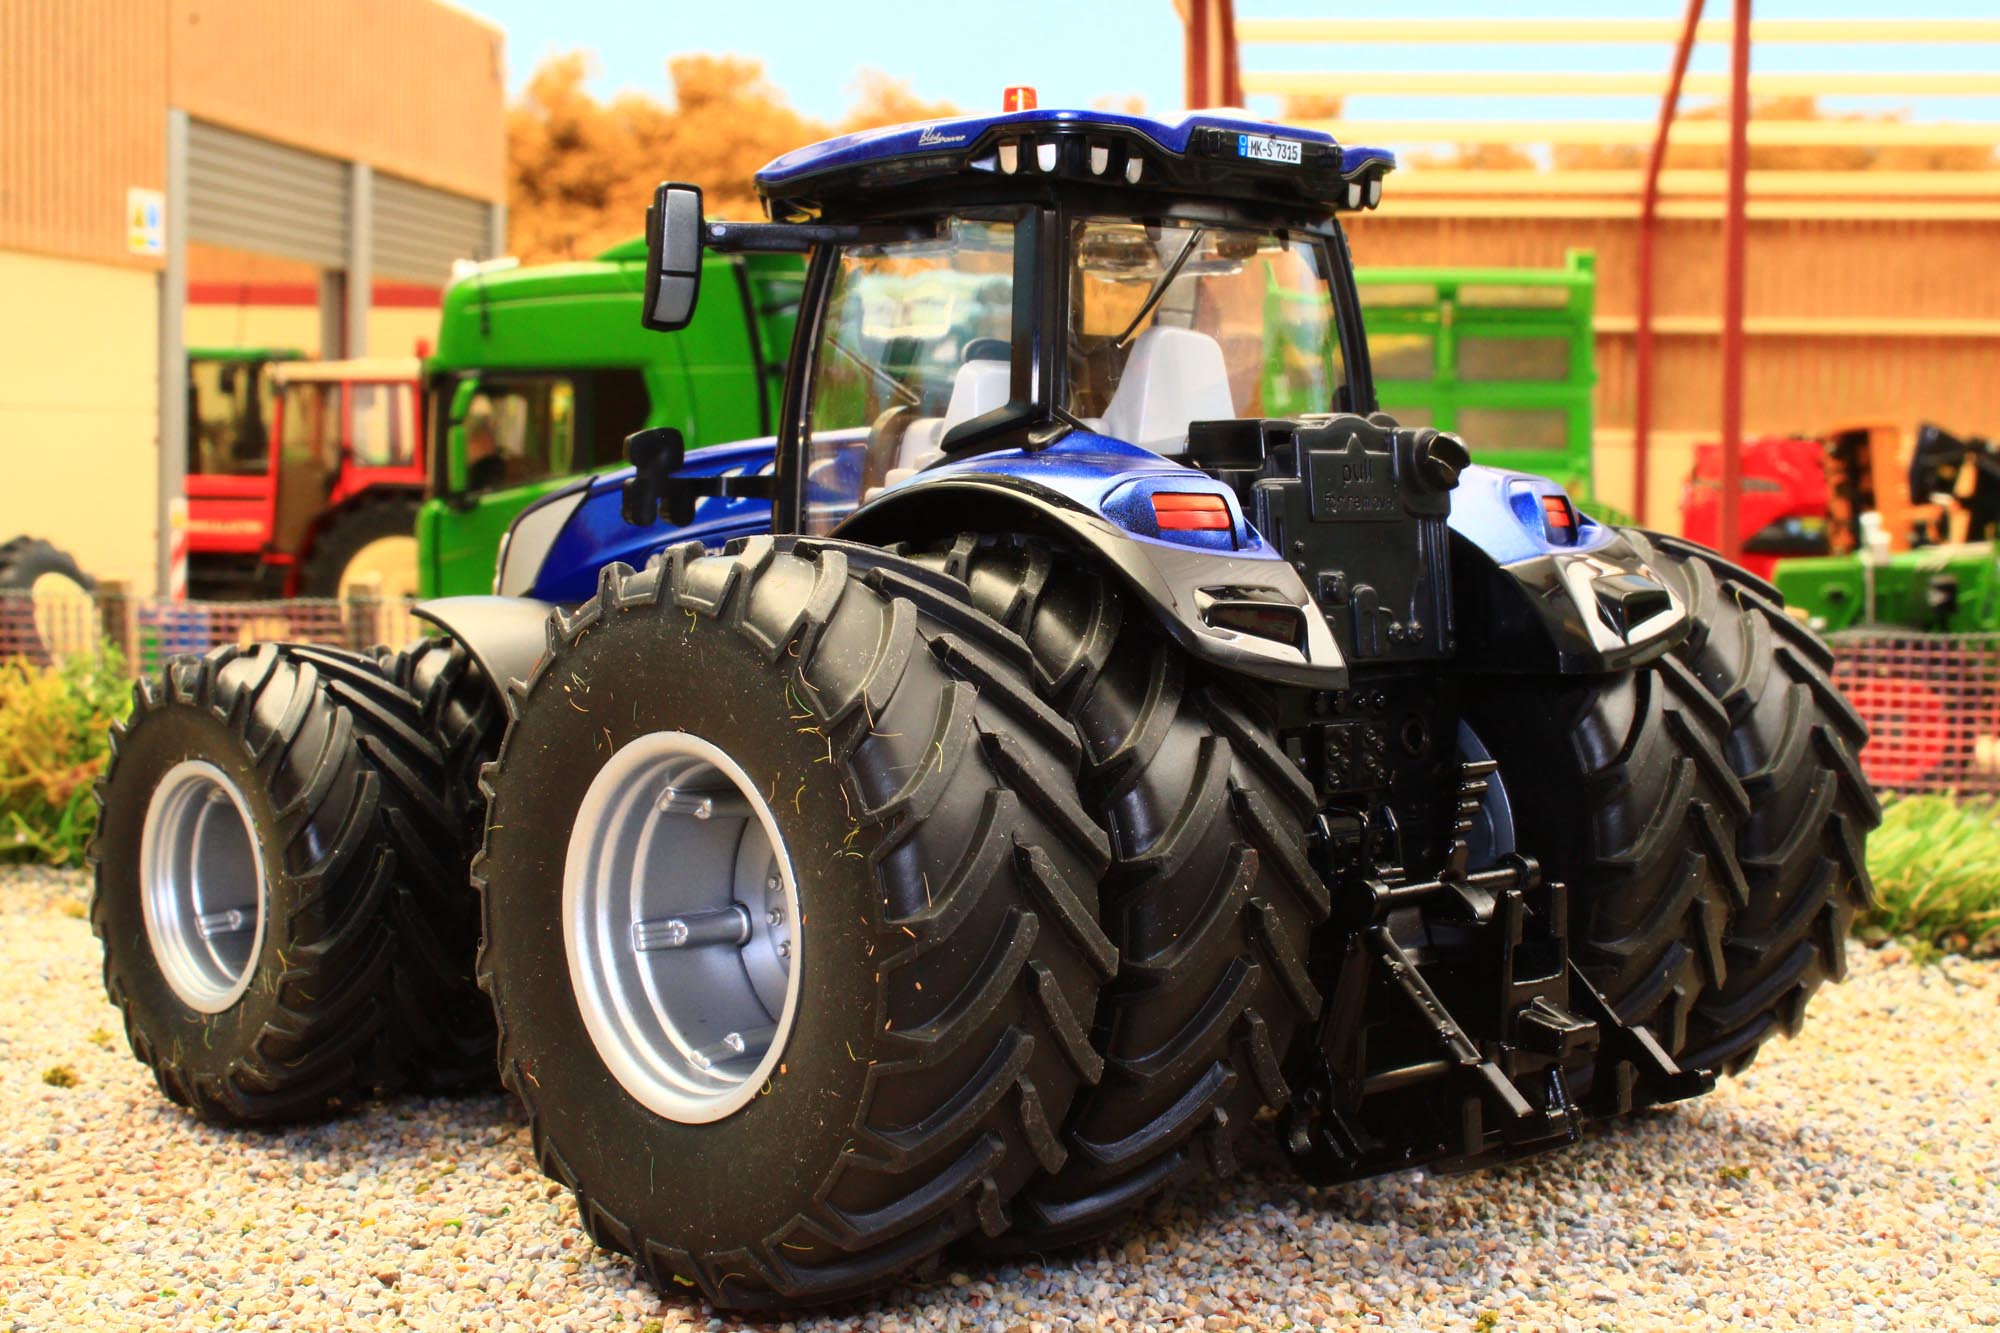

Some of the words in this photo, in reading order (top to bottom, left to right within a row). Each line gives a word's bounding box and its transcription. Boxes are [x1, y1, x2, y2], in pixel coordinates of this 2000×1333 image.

[1250, 139, 1273, 157] MK-S
[1276, 143, 1298, 161] 7315
[1342, 459, 1374, 488] pull
